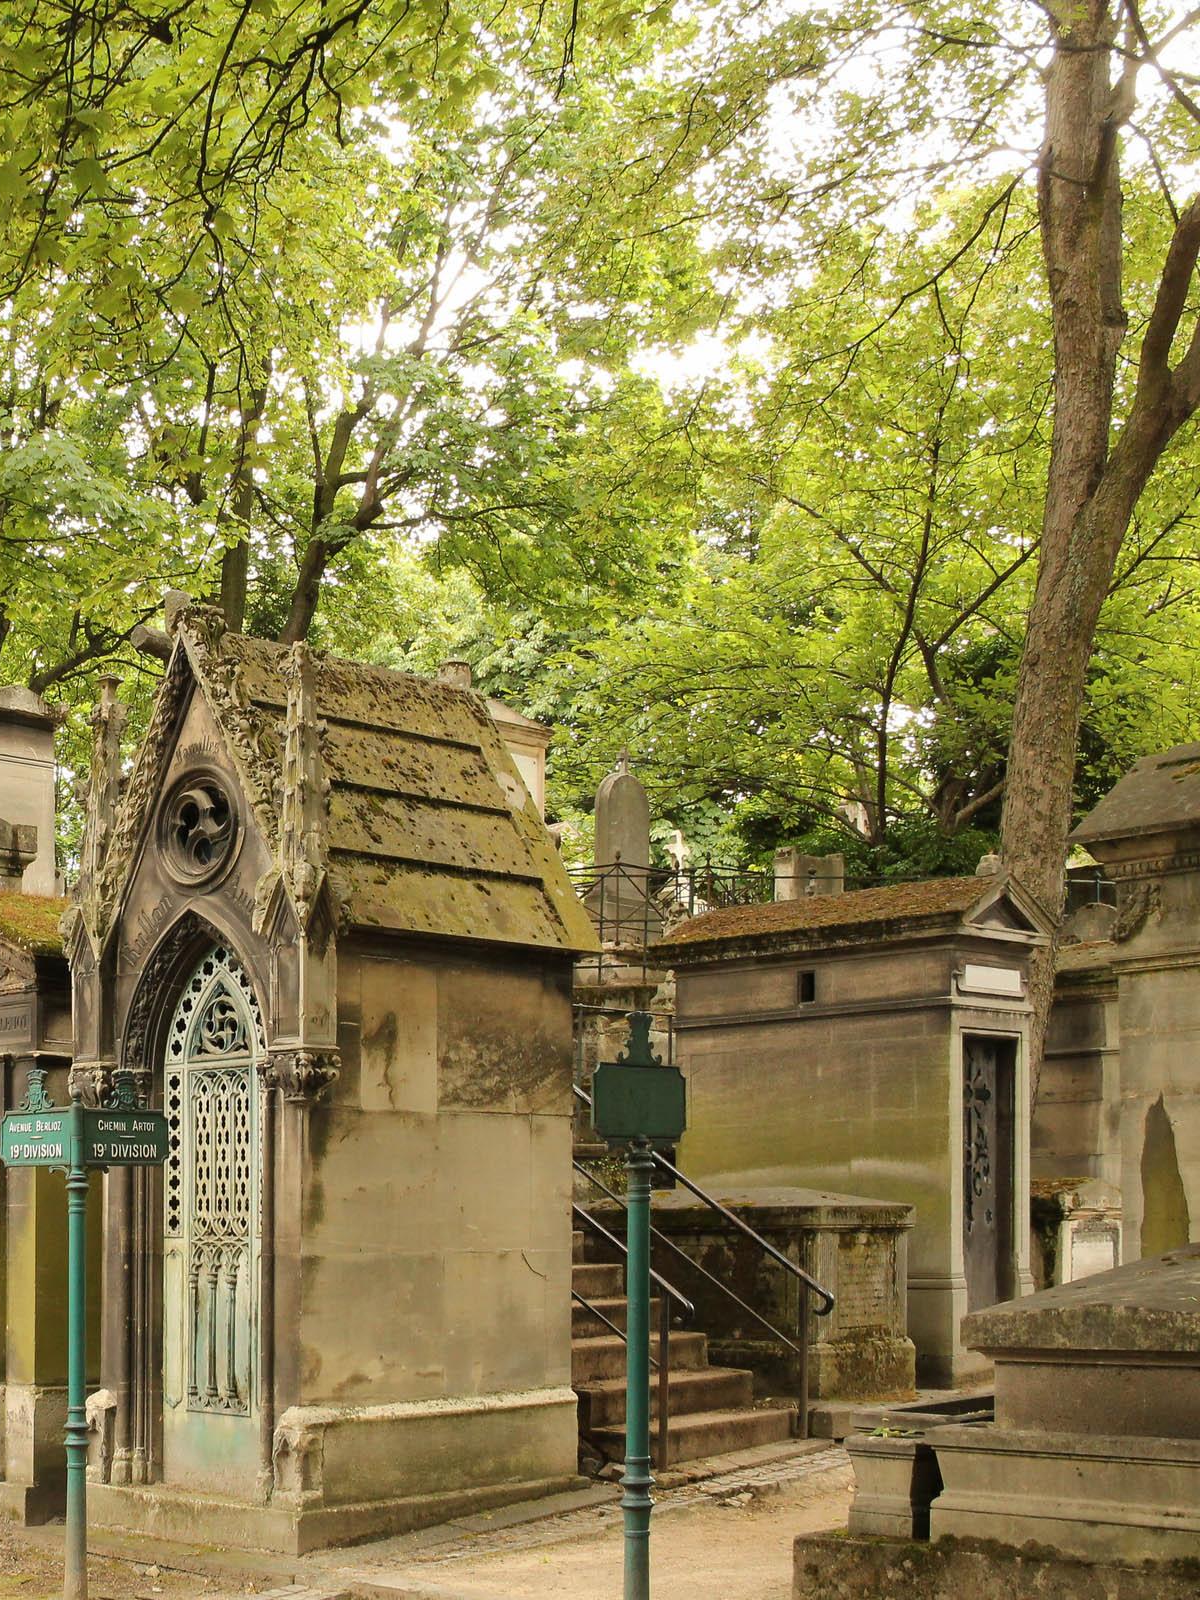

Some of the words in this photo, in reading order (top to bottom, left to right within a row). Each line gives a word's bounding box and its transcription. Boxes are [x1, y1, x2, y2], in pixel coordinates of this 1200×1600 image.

[35, 1119, 62, 1132] BERLIOZ
[97, 1119, 127, 1131] CHEMIN
[132, 1119, 155, 1132] ARTOT
[23, 1143, 62, 1158] DIVISION
[110, 1143, 157, 1158] DIVISION
